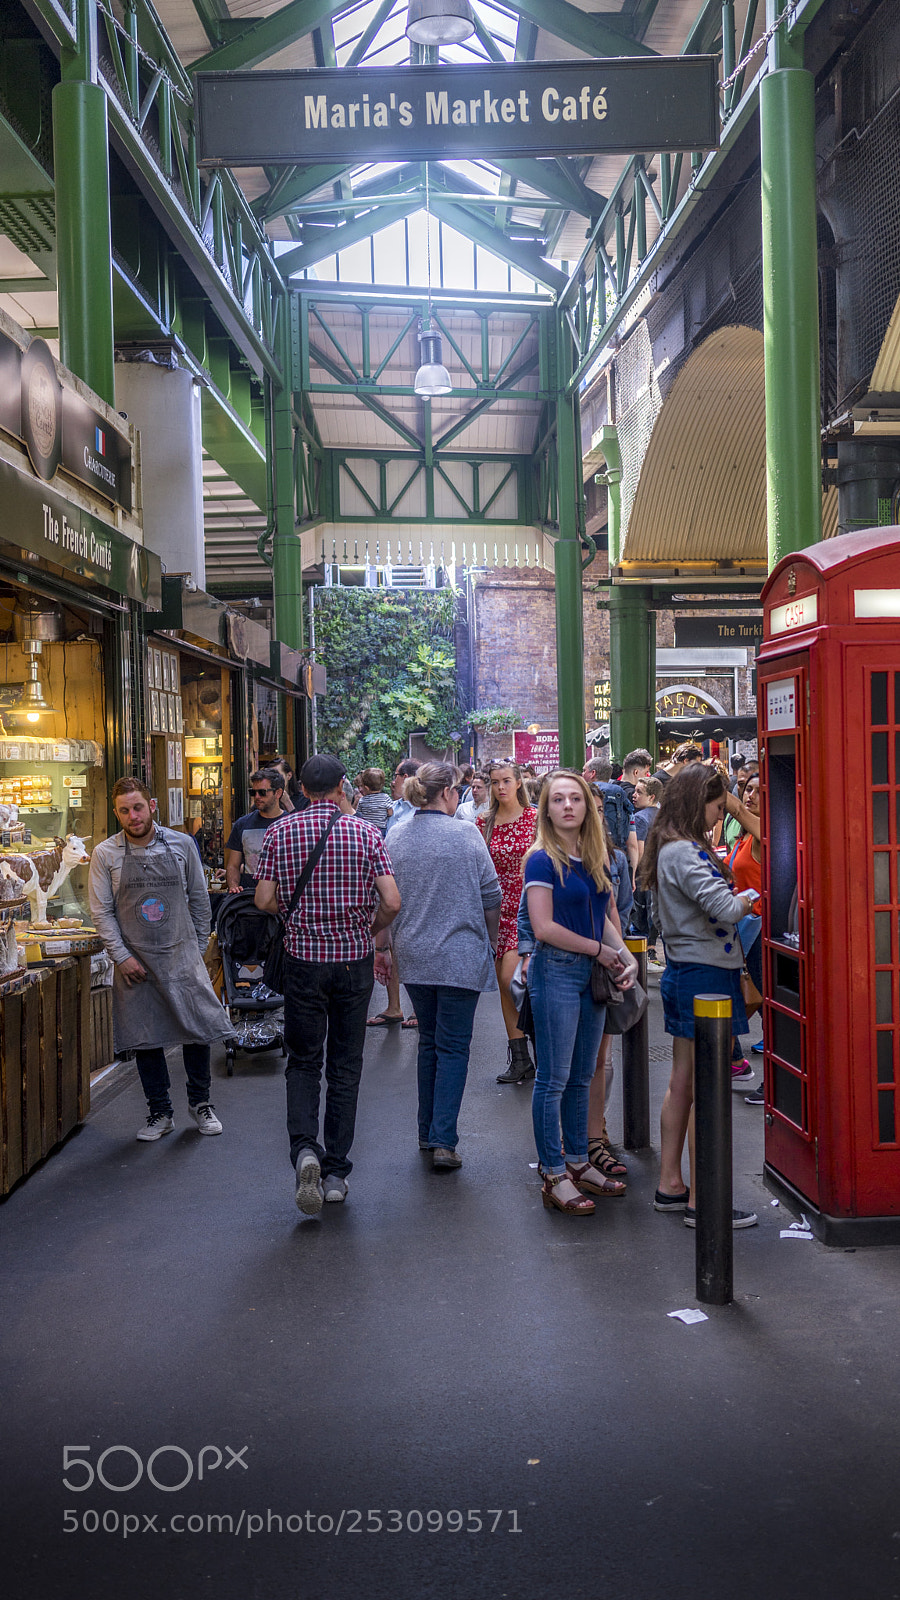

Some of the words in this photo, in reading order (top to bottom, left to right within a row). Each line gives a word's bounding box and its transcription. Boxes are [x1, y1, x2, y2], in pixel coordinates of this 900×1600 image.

[304, 92, 413, 129] Maria's
[425, 90, 530, 125] Market
[541, 86, 608, 122] Café
[42, 503, 59, 544] The
[62, 515, 88, 559] French
[90, 531, 112, 571] Comté
[717, 625, 735, 636] The
[738, 624, 763, 636] Turki
[785, 603, 804, 628] CASH
